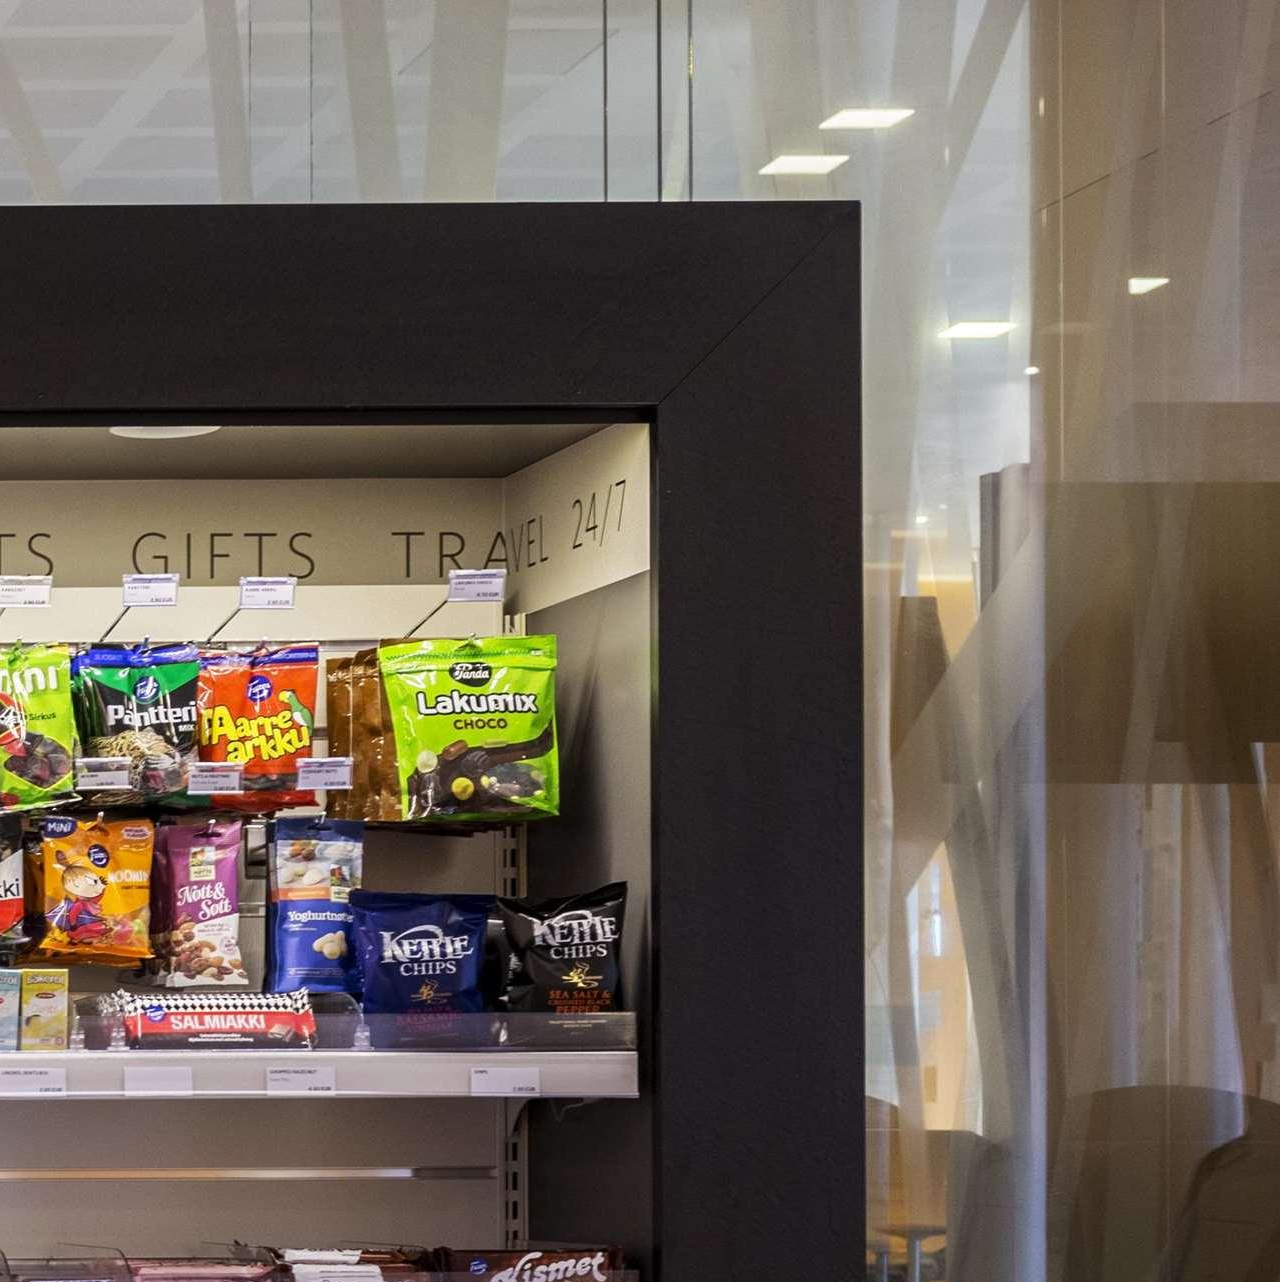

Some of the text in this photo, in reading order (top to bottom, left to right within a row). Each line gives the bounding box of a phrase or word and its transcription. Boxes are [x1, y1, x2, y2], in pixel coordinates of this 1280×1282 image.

[132, 532, 316, 578] GIFTS
[572, 479, 626, 549] 24/7
[453, 663, 490, 681] Panda
[416, 690, 539, 716] Lakumix
[28, 711, 57, 722] Sirkus
[107, 702, 196, 727] Pantteri
[177, 723, 196, 732] MIX
[211, 705, 293, 745] Aarre
[453, 718, 508, 730] CHOCO
[226, 727, 311, 765] arkku
[532, 909, 620, 947] KETTLE
[379, 924, 474, 964] KETTLE
[550, 943, 609, 960] CHIPS
[399, 960, 457, 976] CHIPS
[549, 990, 570, 1000] SEA
[573, 990, 600, 1000] SALT
[171, 1015, 266, 1030] SALMIAKKI
